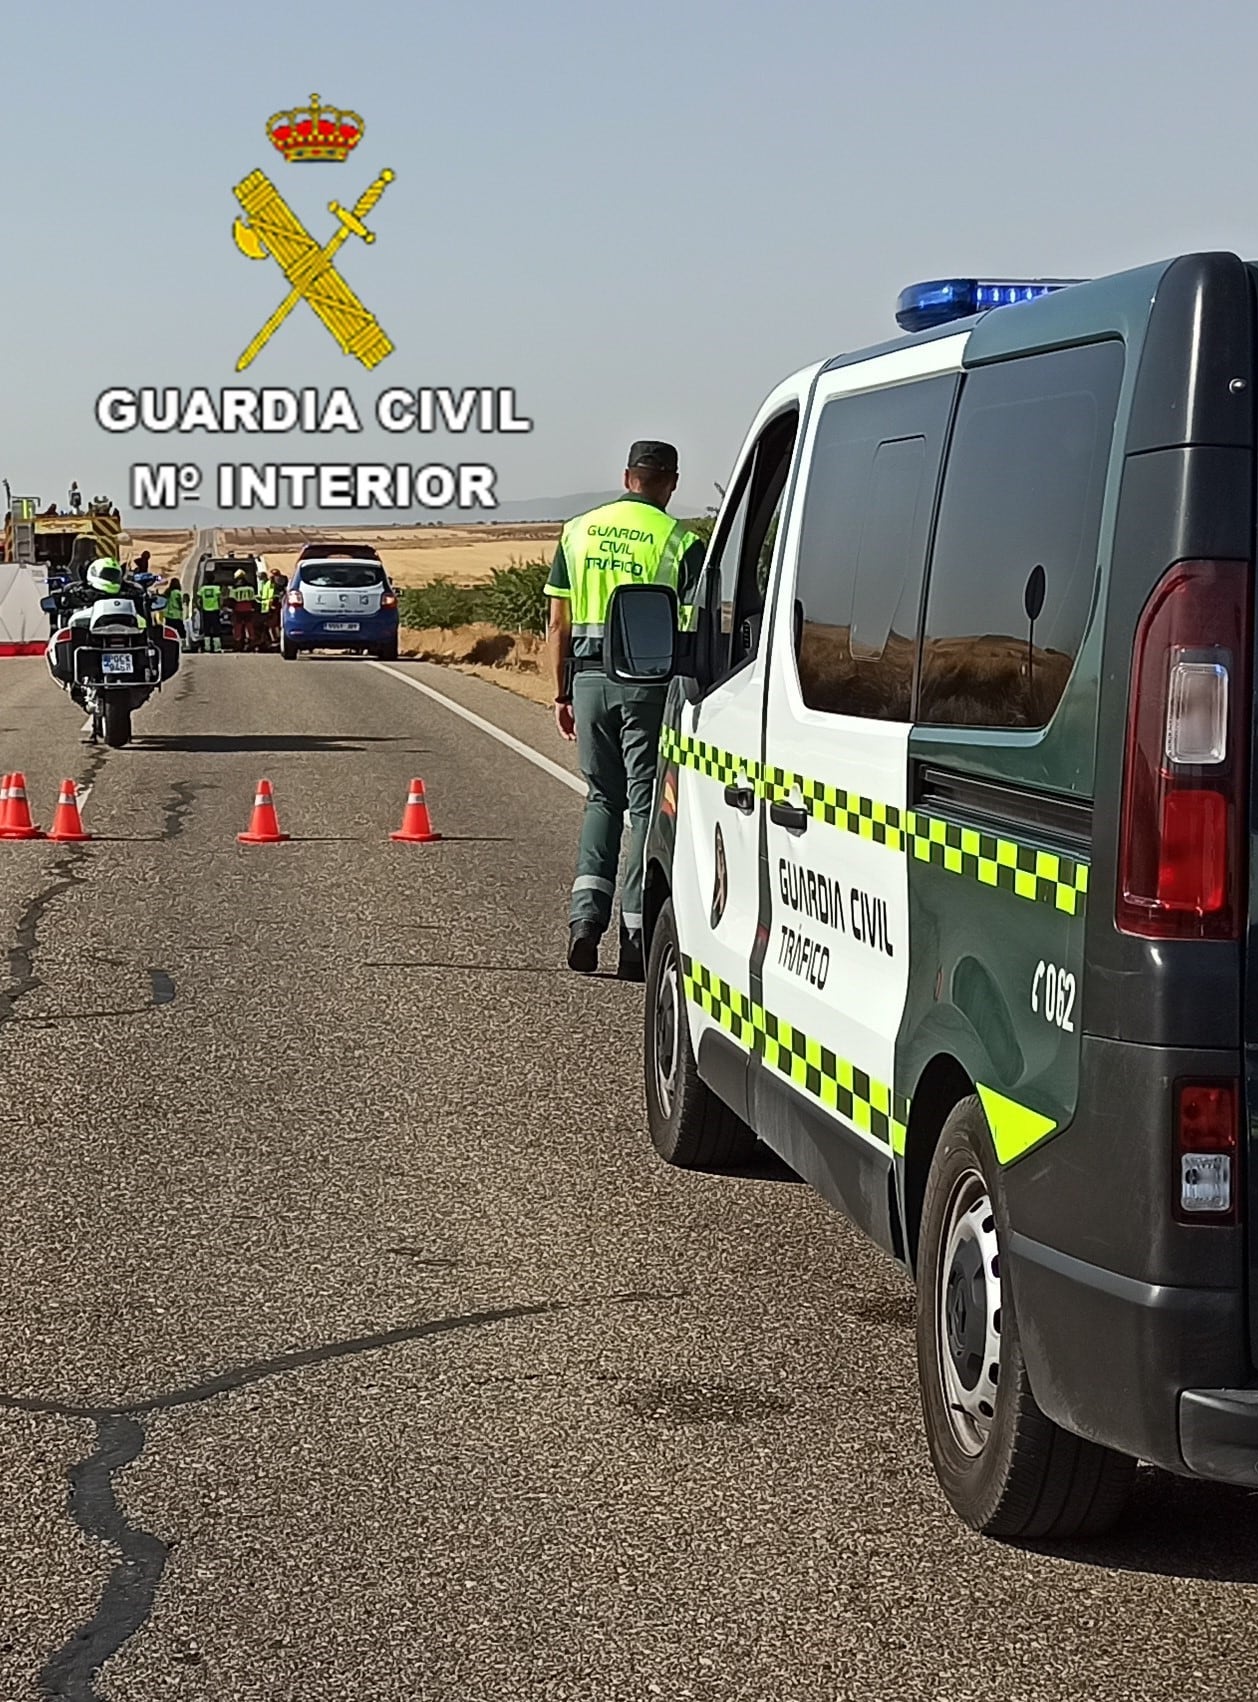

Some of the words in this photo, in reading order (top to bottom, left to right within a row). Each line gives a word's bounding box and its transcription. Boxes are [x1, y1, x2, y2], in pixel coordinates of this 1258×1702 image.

[587, 525, 654, 545] GUARDIA
[600, 540, 632, 555] CIVIL
[779, 857, 845, 933] GUARDIA
[850, 887, 893, 957] CIVIL
[778, 923, 829, 990] TRÁFICO
[1045, 963, 1076, 1033] 062
